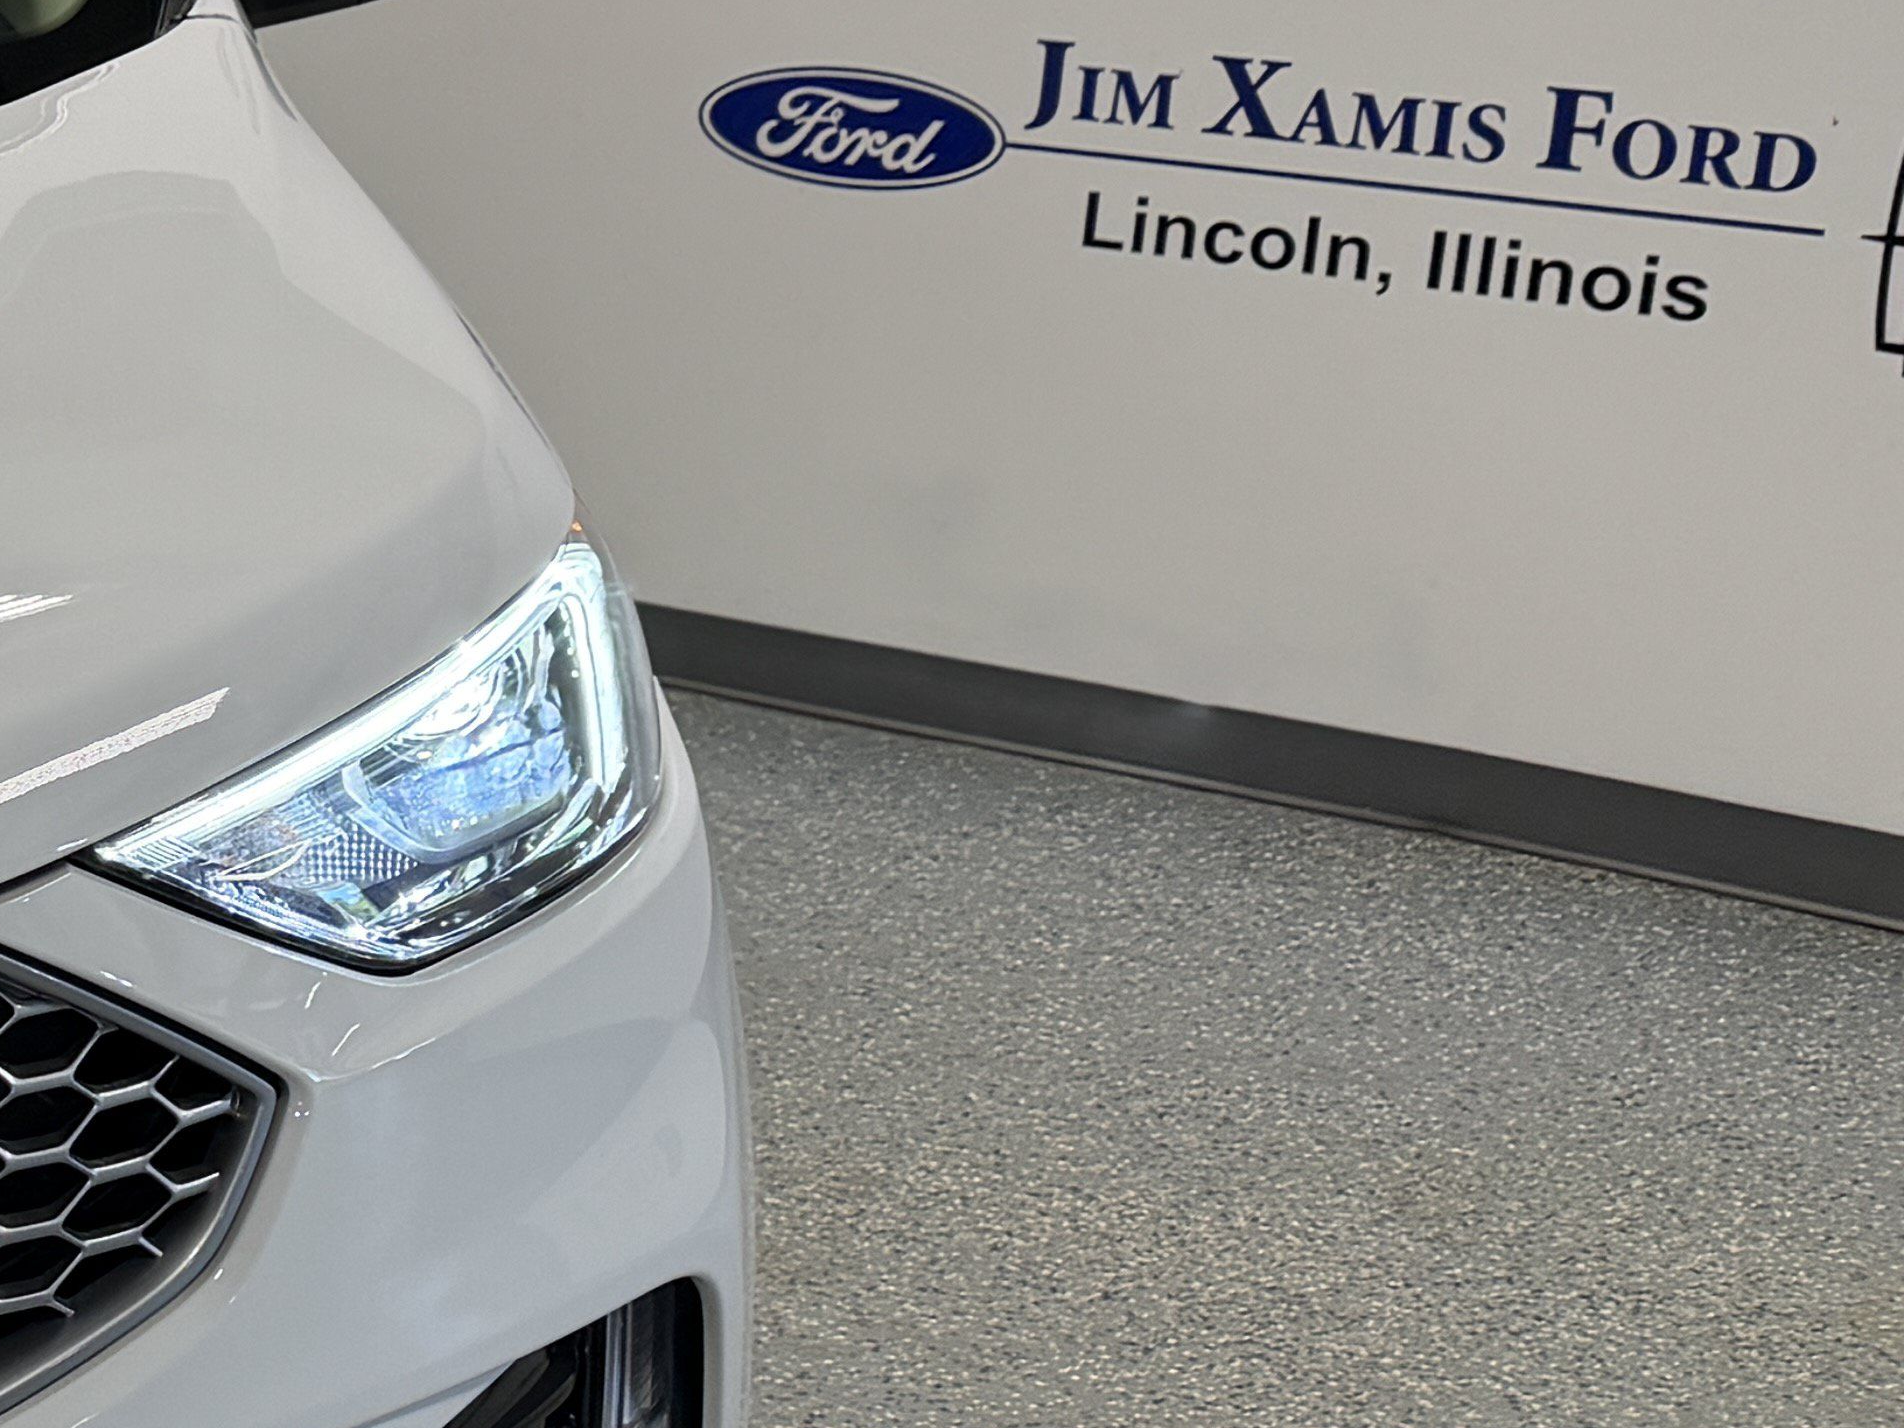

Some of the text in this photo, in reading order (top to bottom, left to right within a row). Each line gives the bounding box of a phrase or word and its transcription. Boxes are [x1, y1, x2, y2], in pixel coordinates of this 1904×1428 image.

[756, 87, 937, 176] Ford
[1025, 39, 1817, 193] JIM XAMIS FORD
[1082, 192, 1709, 322] Lincoln, Illinois
